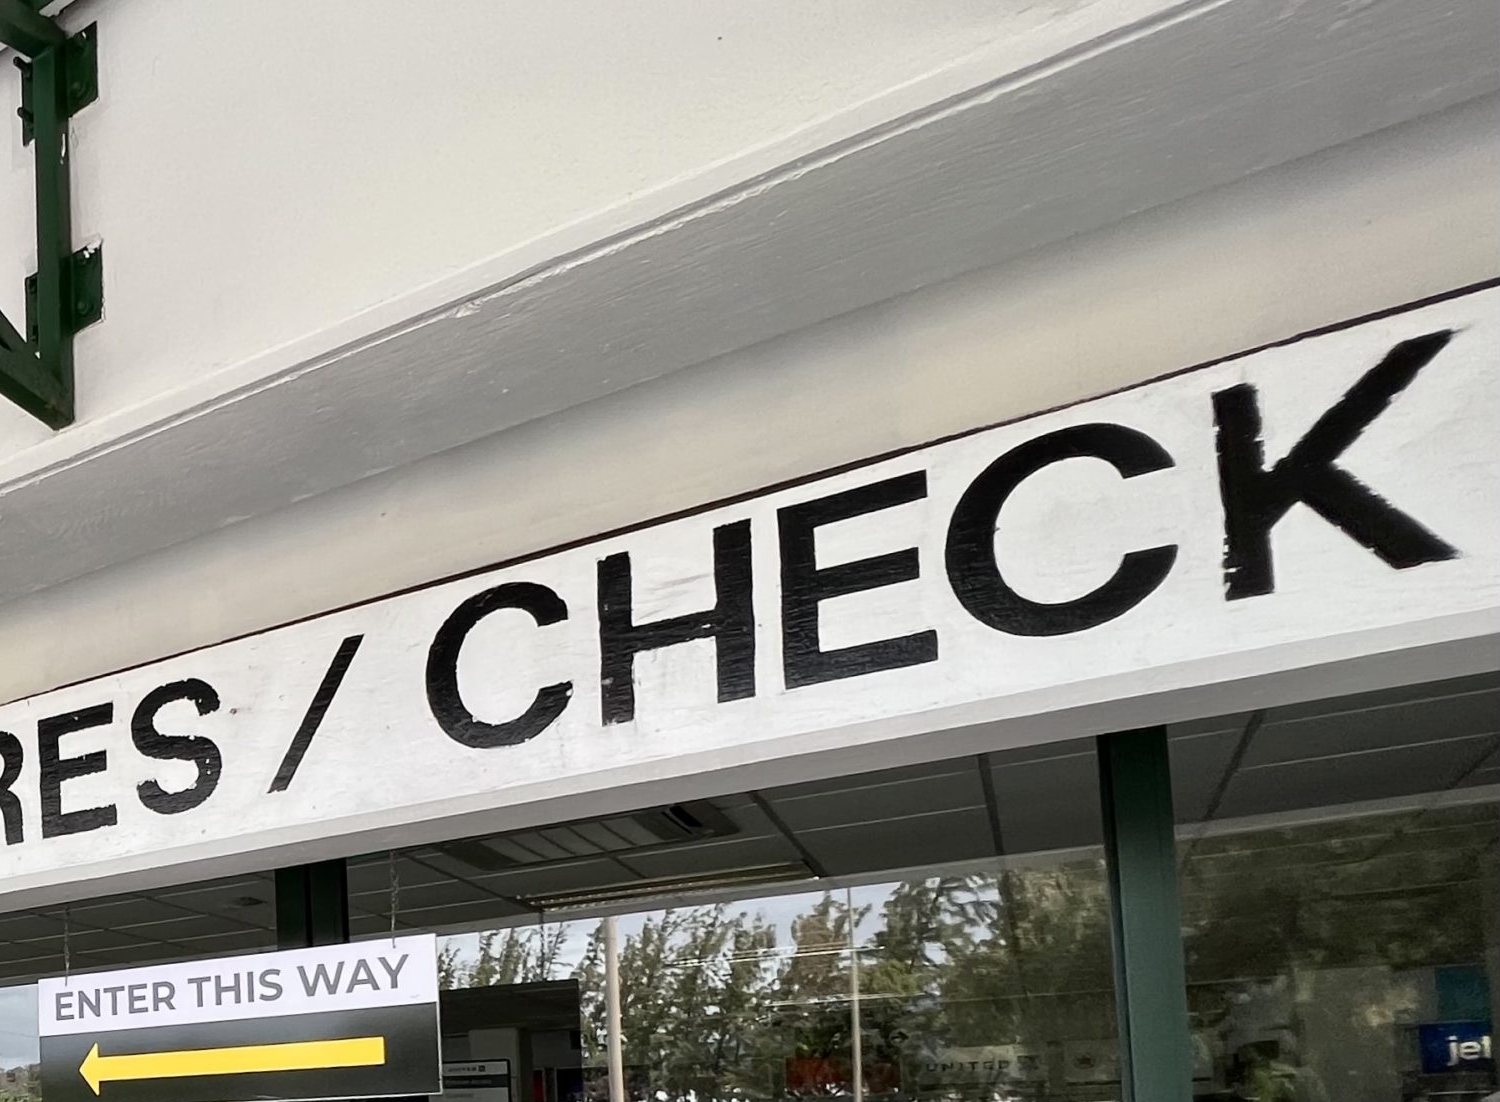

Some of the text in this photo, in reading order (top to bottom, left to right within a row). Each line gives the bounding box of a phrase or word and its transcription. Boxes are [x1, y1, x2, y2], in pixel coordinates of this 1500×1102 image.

[268, 634, 364, 793] /
[425, 328, 1464, 749] CHECK
[55, 954, 409, 1021] ENTER THIS WAY
[926, 1060, 1008, 1073] UNITED
